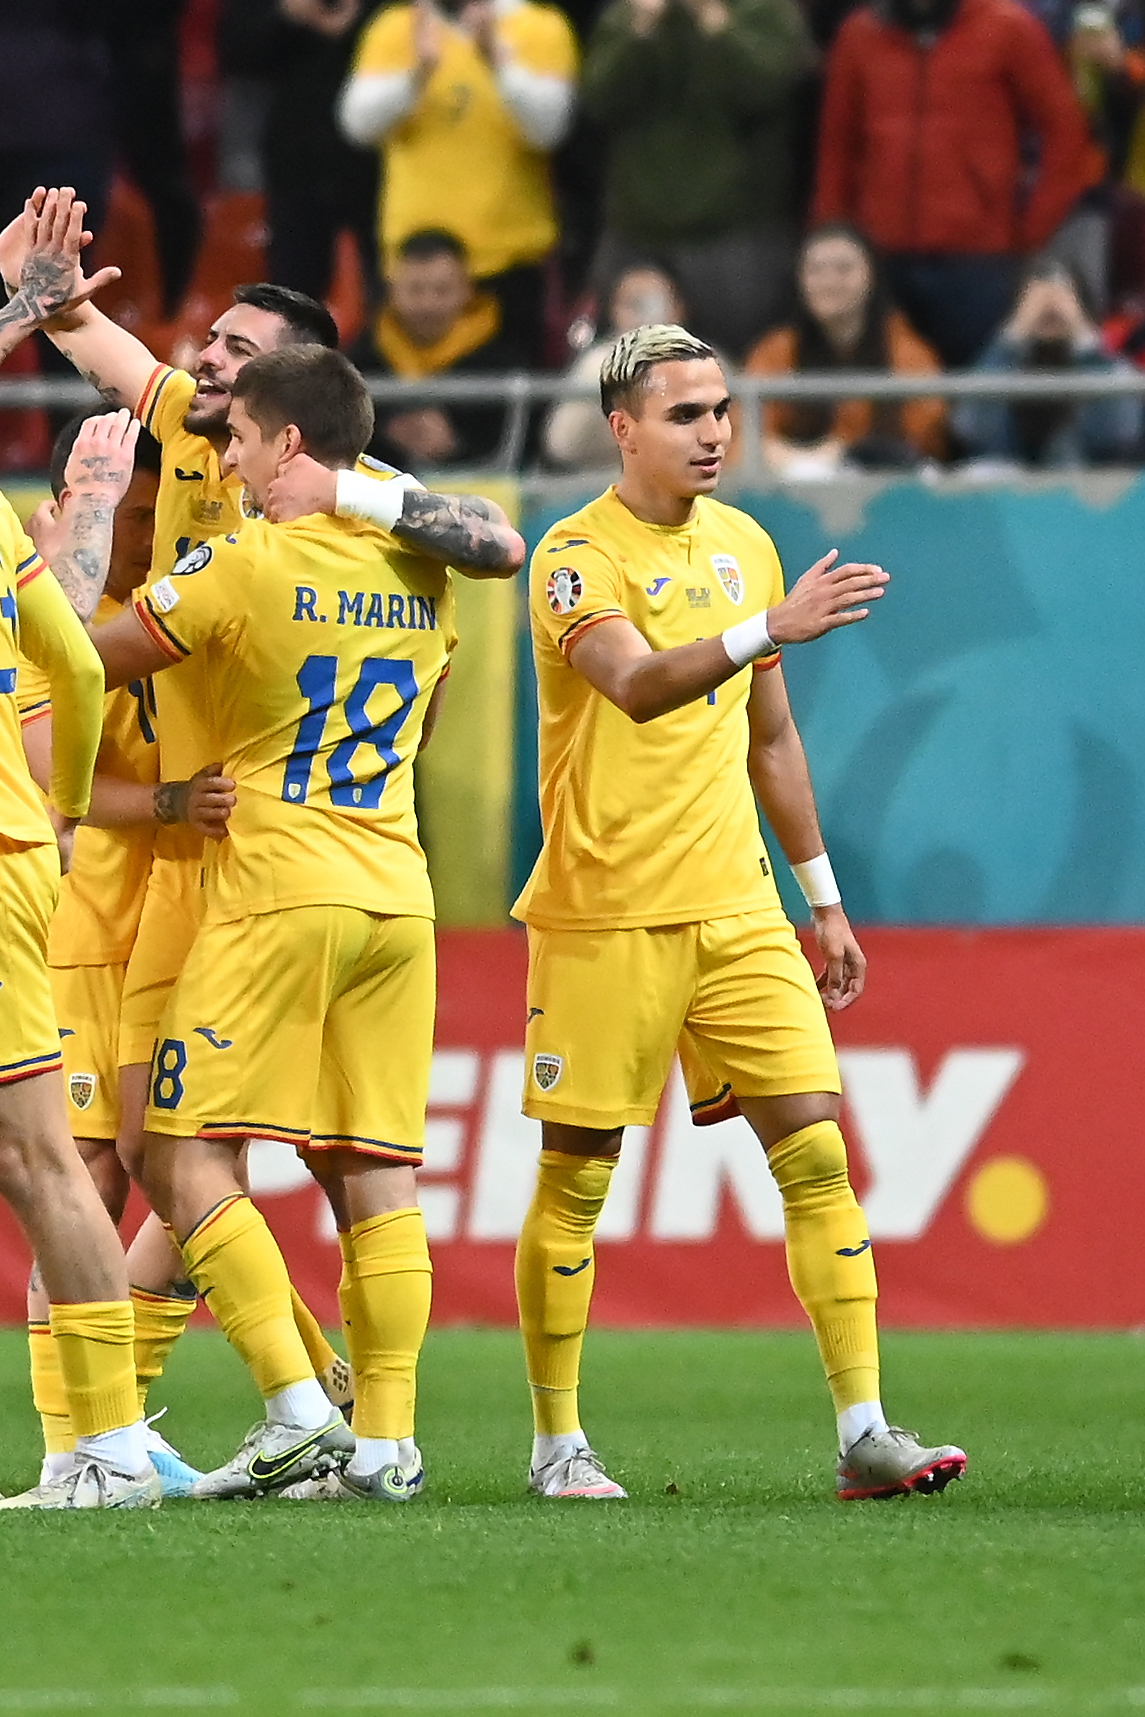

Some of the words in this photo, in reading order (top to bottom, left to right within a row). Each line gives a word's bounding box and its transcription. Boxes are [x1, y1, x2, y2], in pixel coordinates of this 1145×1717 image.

[292, 586, 327, 623] R.
[336, 590, 436, 631] MARIN
[281, 654, 419, 809] 18
